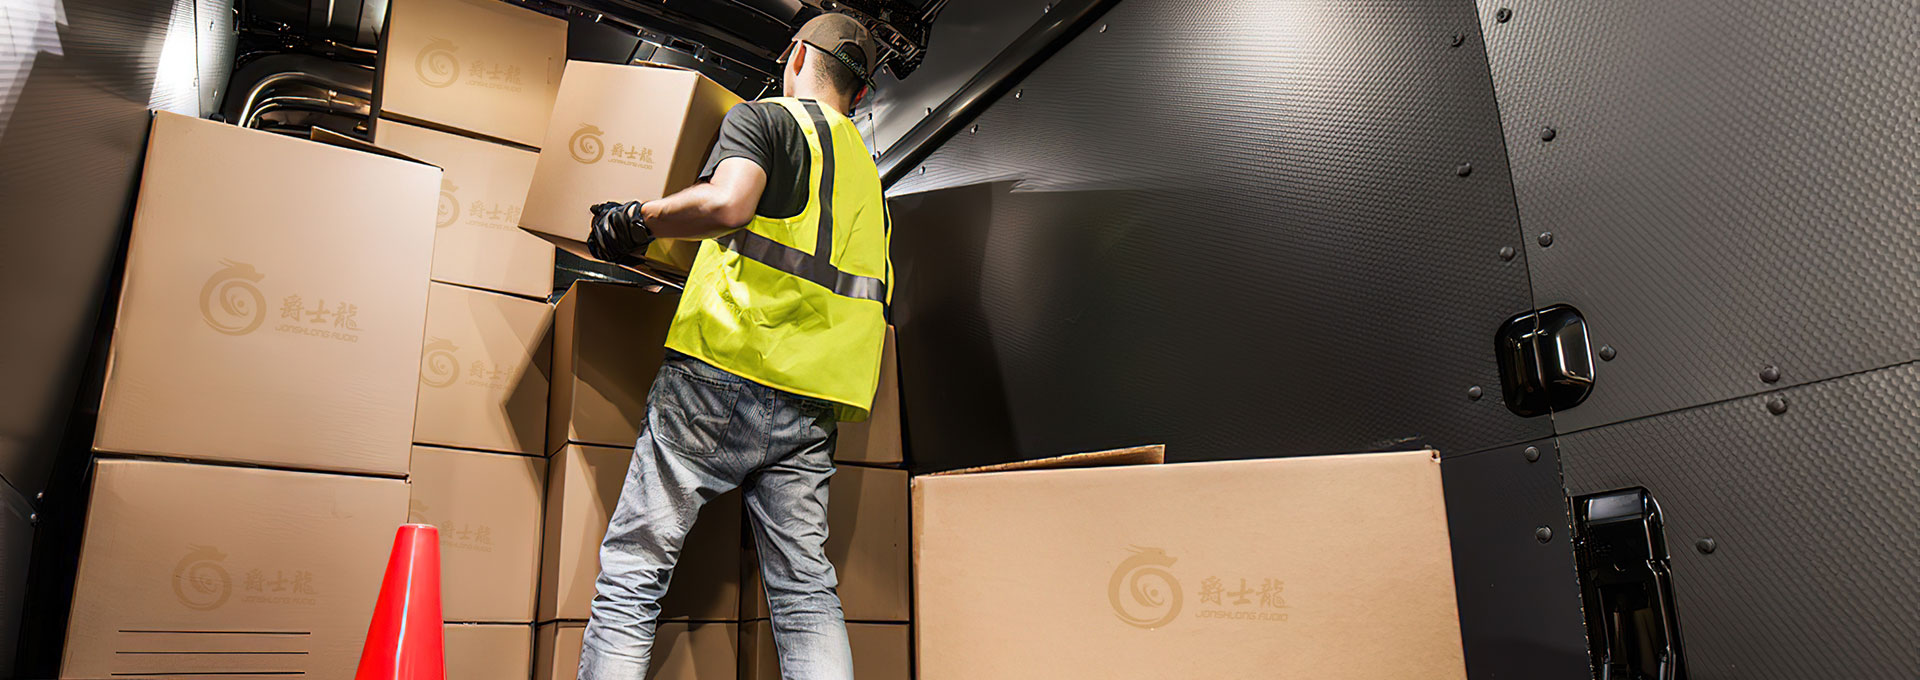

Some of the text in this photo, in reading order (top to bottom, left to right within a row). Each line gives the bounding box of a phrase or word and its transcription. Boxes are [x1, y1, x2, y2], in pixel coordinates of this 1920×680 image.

[468, 60, 523, 85] 爵士龍
[610, 142, 655, 163] 爵士龍
[280, 294, 364, 331] 爵士龍
[243, 568, 320, 595] 爵士龍
[1198, 575, 1293, 608] 爵士龍
[1257, 612, 1288, 622] AUDIO
